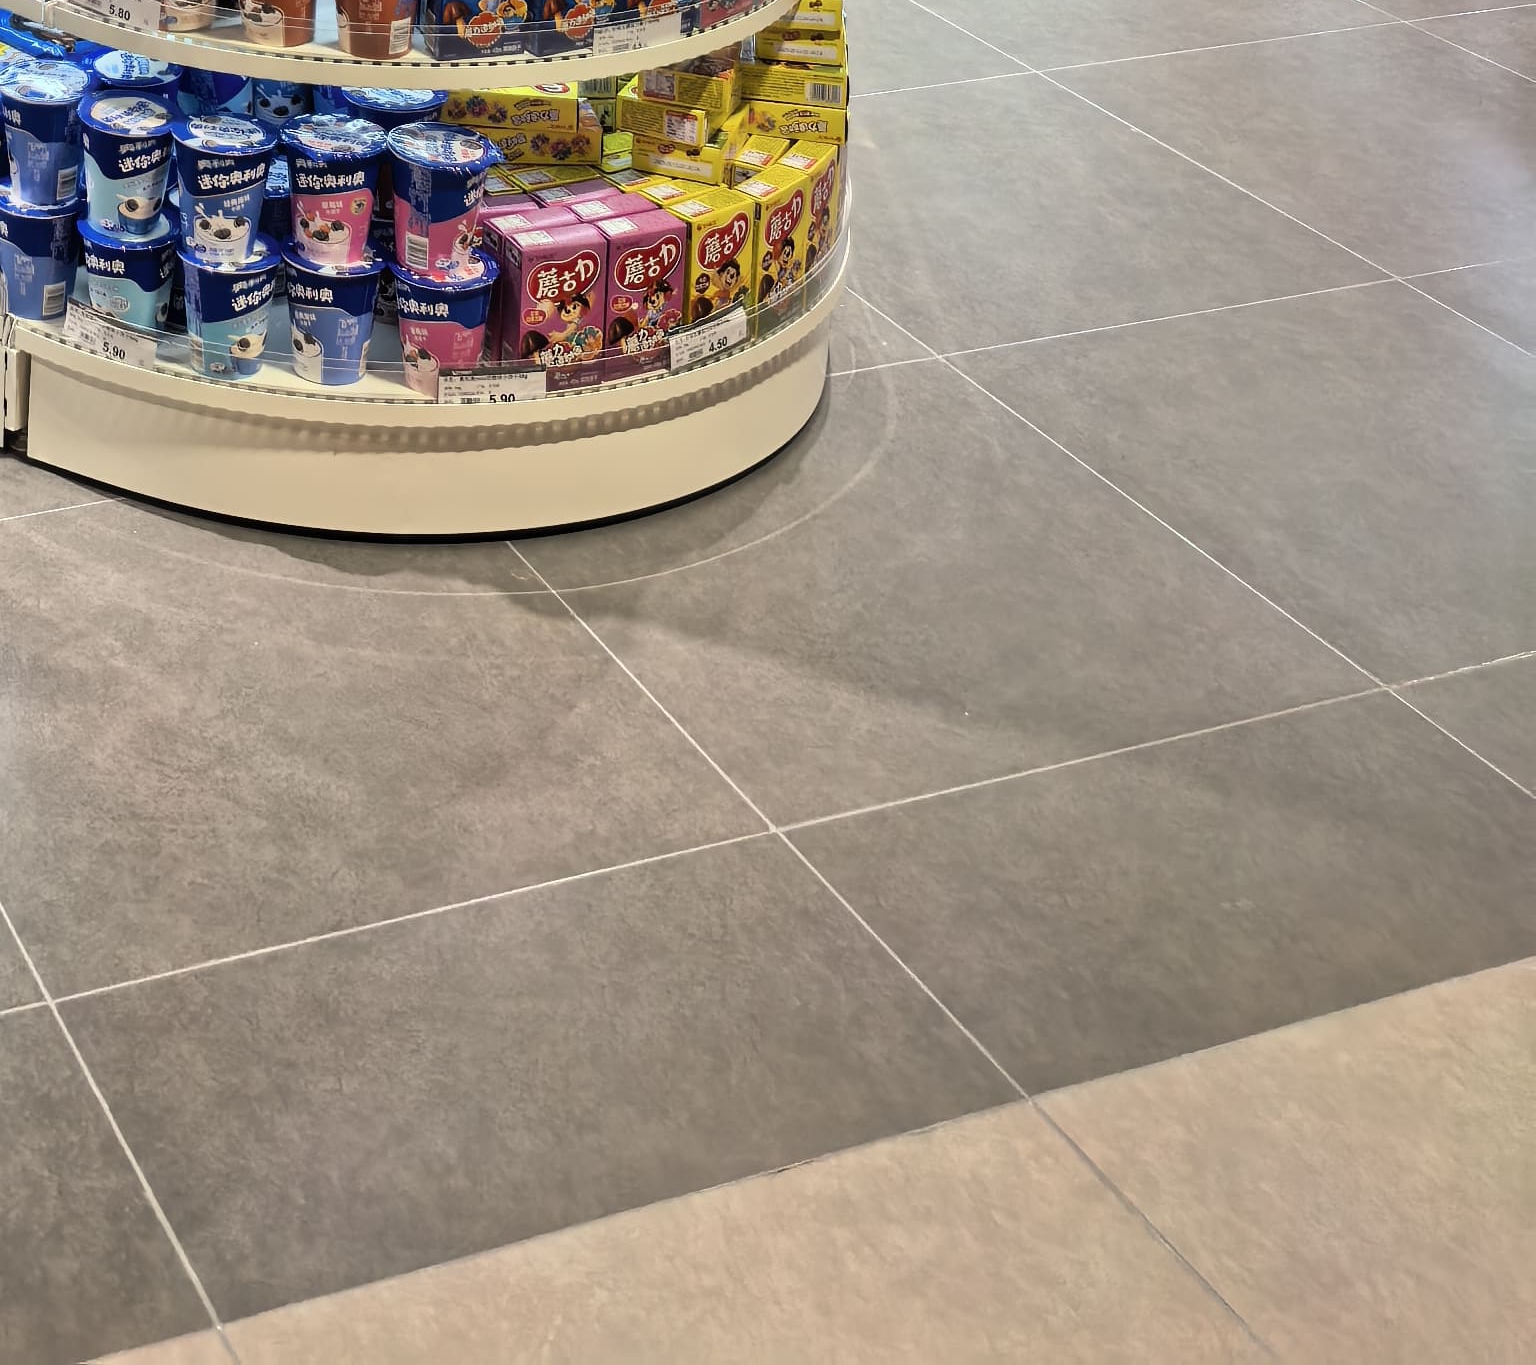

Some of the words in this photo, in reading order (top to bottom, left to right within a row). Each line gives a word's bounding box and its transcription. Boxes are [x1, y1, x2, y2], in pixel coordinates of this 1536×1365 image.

[109, 3, 131, 21] 5.80
[197, 163, 265, 190] 迷你奥利奥
[295, 171, 365, 189] 迷你奥利奥
[767, 198, 803, 243] 蘑古力
[704, 221, 747, 262] 蘑古力
[624, 242, 677, 286] 蘑古力
[537, 257, 594, 298] 蘑古力
[103, 342, 126, 360] 5.90
[708, 336, 728, 353] 4.50
[489, 393, 515, 403] 5.90
